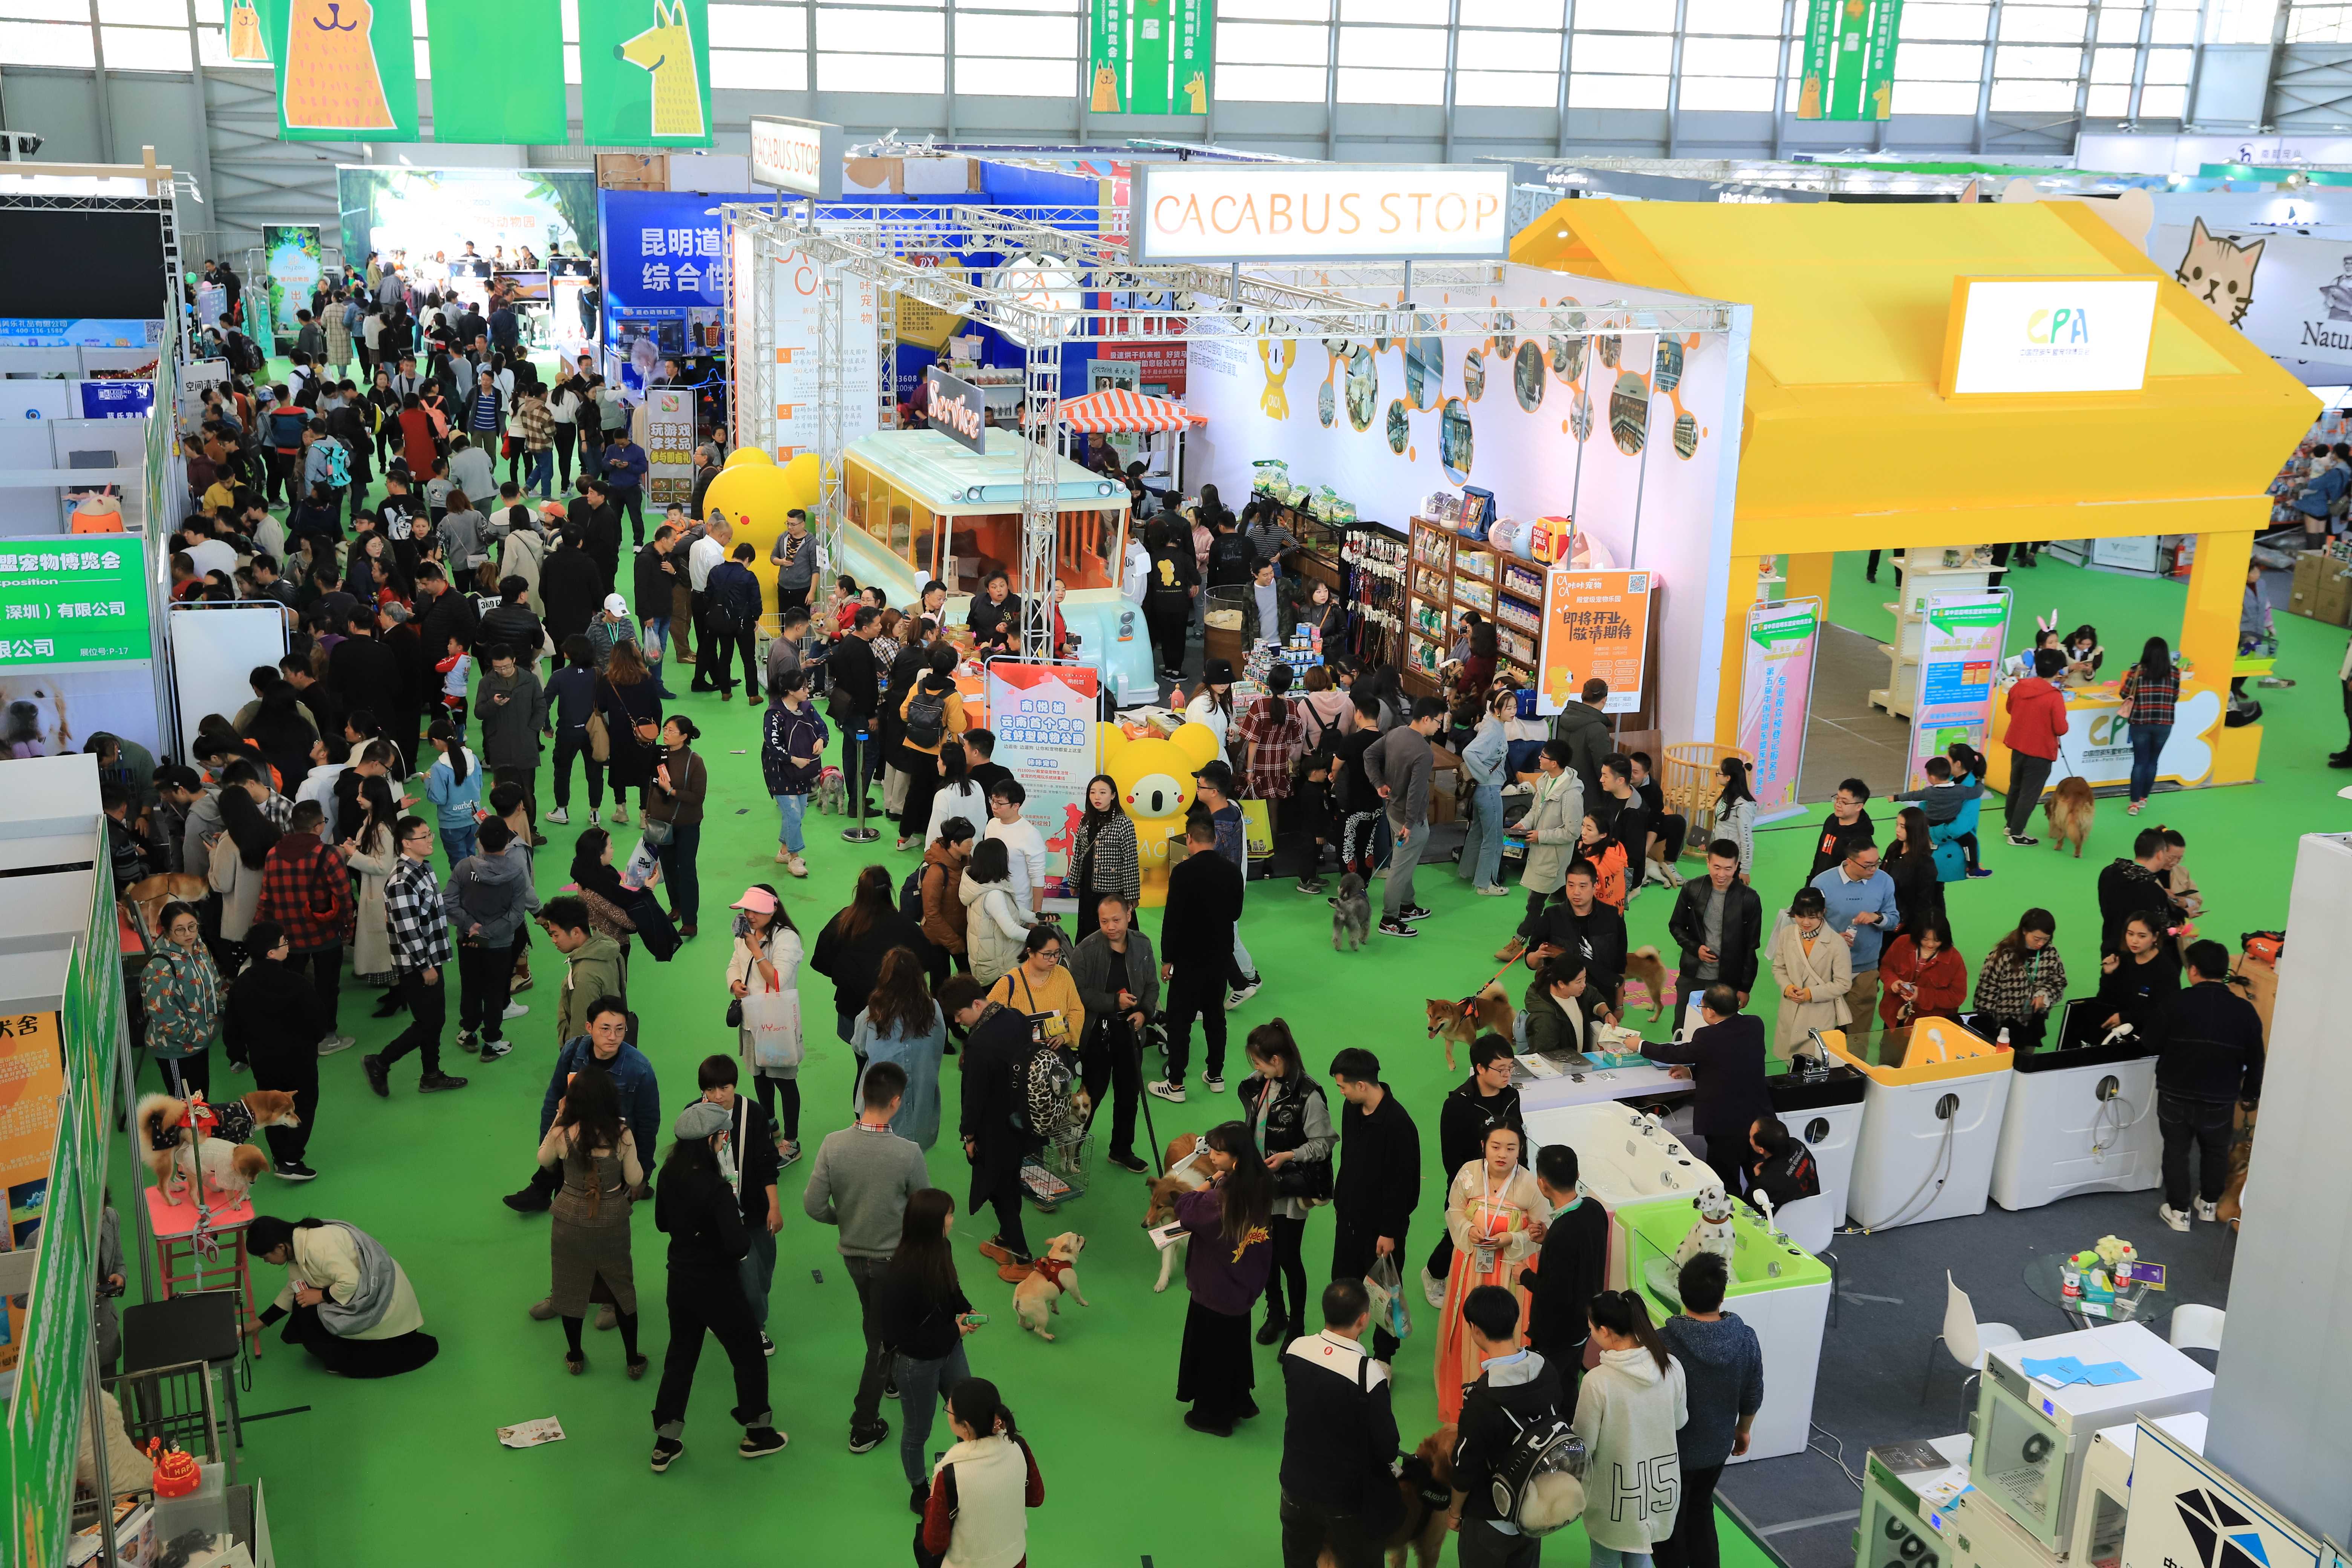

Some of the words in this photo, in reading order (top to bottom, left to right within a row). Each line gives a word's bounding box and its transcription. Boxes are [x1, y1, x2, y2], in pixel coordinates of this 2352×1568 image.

[753, 136, 792, 171] CACABUS
[795, 141, 820, 176] STOP
[1154, 192, 1361, 236] CACABUS
[1379, 192, 1498, 234] STOP
[642, 228, 732, 257] 昆明道
[2027, 308, 2088, 343] CPA
[2302, 321, 2352, 350] Natu
[929, 380, 980, 439] Service
[649, 423, 692, 437] 玩游戏
[650, 451, 692, 465] 参与即有礼
[1533, 536, 1546, 546] SMILE
[1568, 581, 1602, 590] 咔咔宠物
[1563, 611, 1622, 631] 即将开业
[1573, 622, 1632, 643] 敬请期待
[1021, 700, 1065, 714] 南悦城
[1001, 715, 1084, 732] 云南首个宠物
[1755, 666, 1774, 795] 第五届中国昆明东盟宠物博览会
[1767, 676, 1787, 783] 专业观众预登记报名点
[1000, 729, 1085, 745] 友好型购物公园
[1028, 758, 1058, 767] 咔咔宠物
[453, 801, 479, 811] Burbery
[1137, 839, 1167, 858] AC
